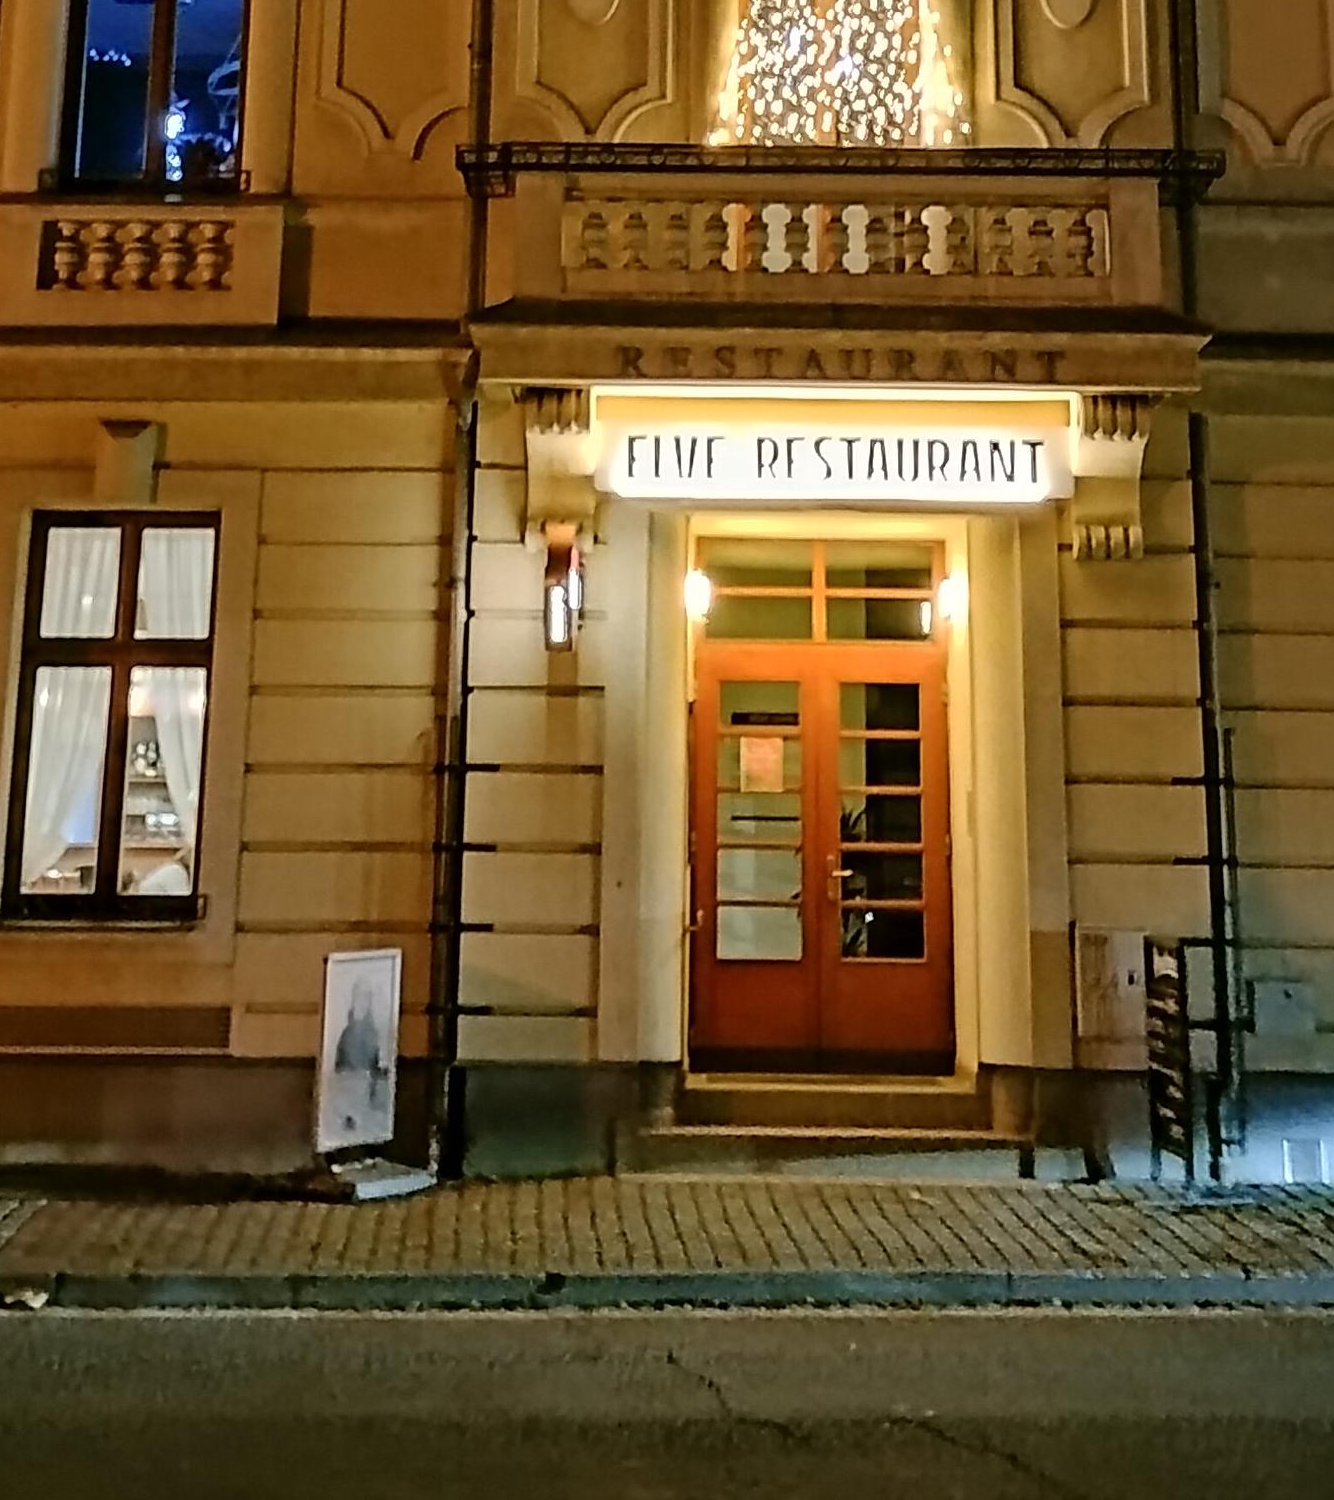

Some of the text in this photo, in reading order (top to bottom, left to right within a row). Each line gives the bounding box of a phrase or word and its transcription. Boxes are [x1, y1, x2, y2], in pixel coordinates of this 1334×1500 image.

[617, 345, 1065, 383] RESTAURANT
[627, 435, 1045, 484] FIVE RESTAURANT
